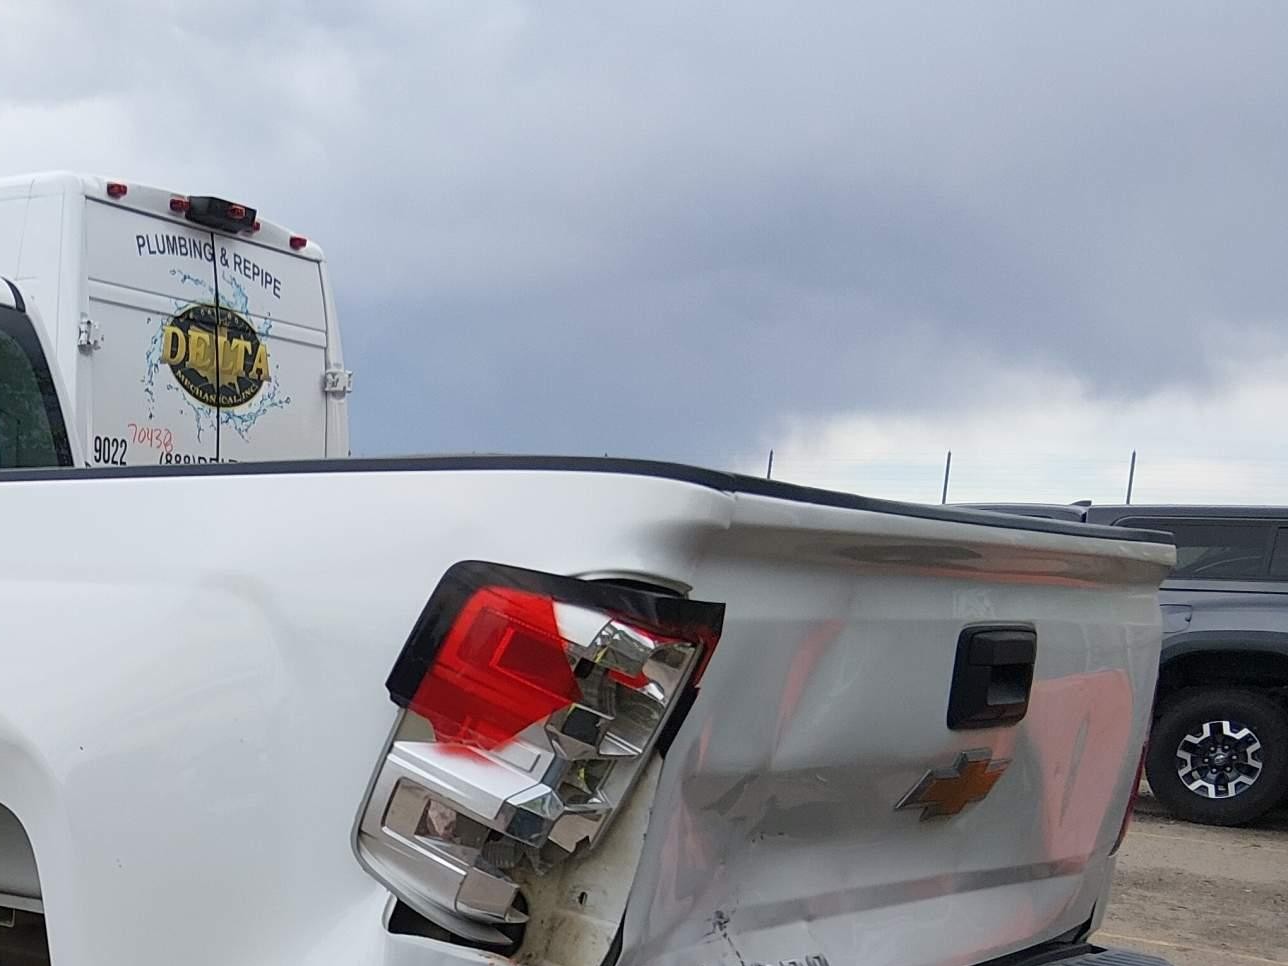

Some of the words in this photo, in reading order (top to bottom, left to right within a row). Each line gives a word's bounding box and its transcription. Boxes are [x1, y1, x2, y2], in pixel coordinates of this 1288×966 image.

[136, 234, 214, 262] PLUMBING
[220, 247, 230, 269] &
[233, 253, 281, 299] REPIPE
[161, 325, 271, 381] DELTA
[94, 436, 128, 466] 9022
